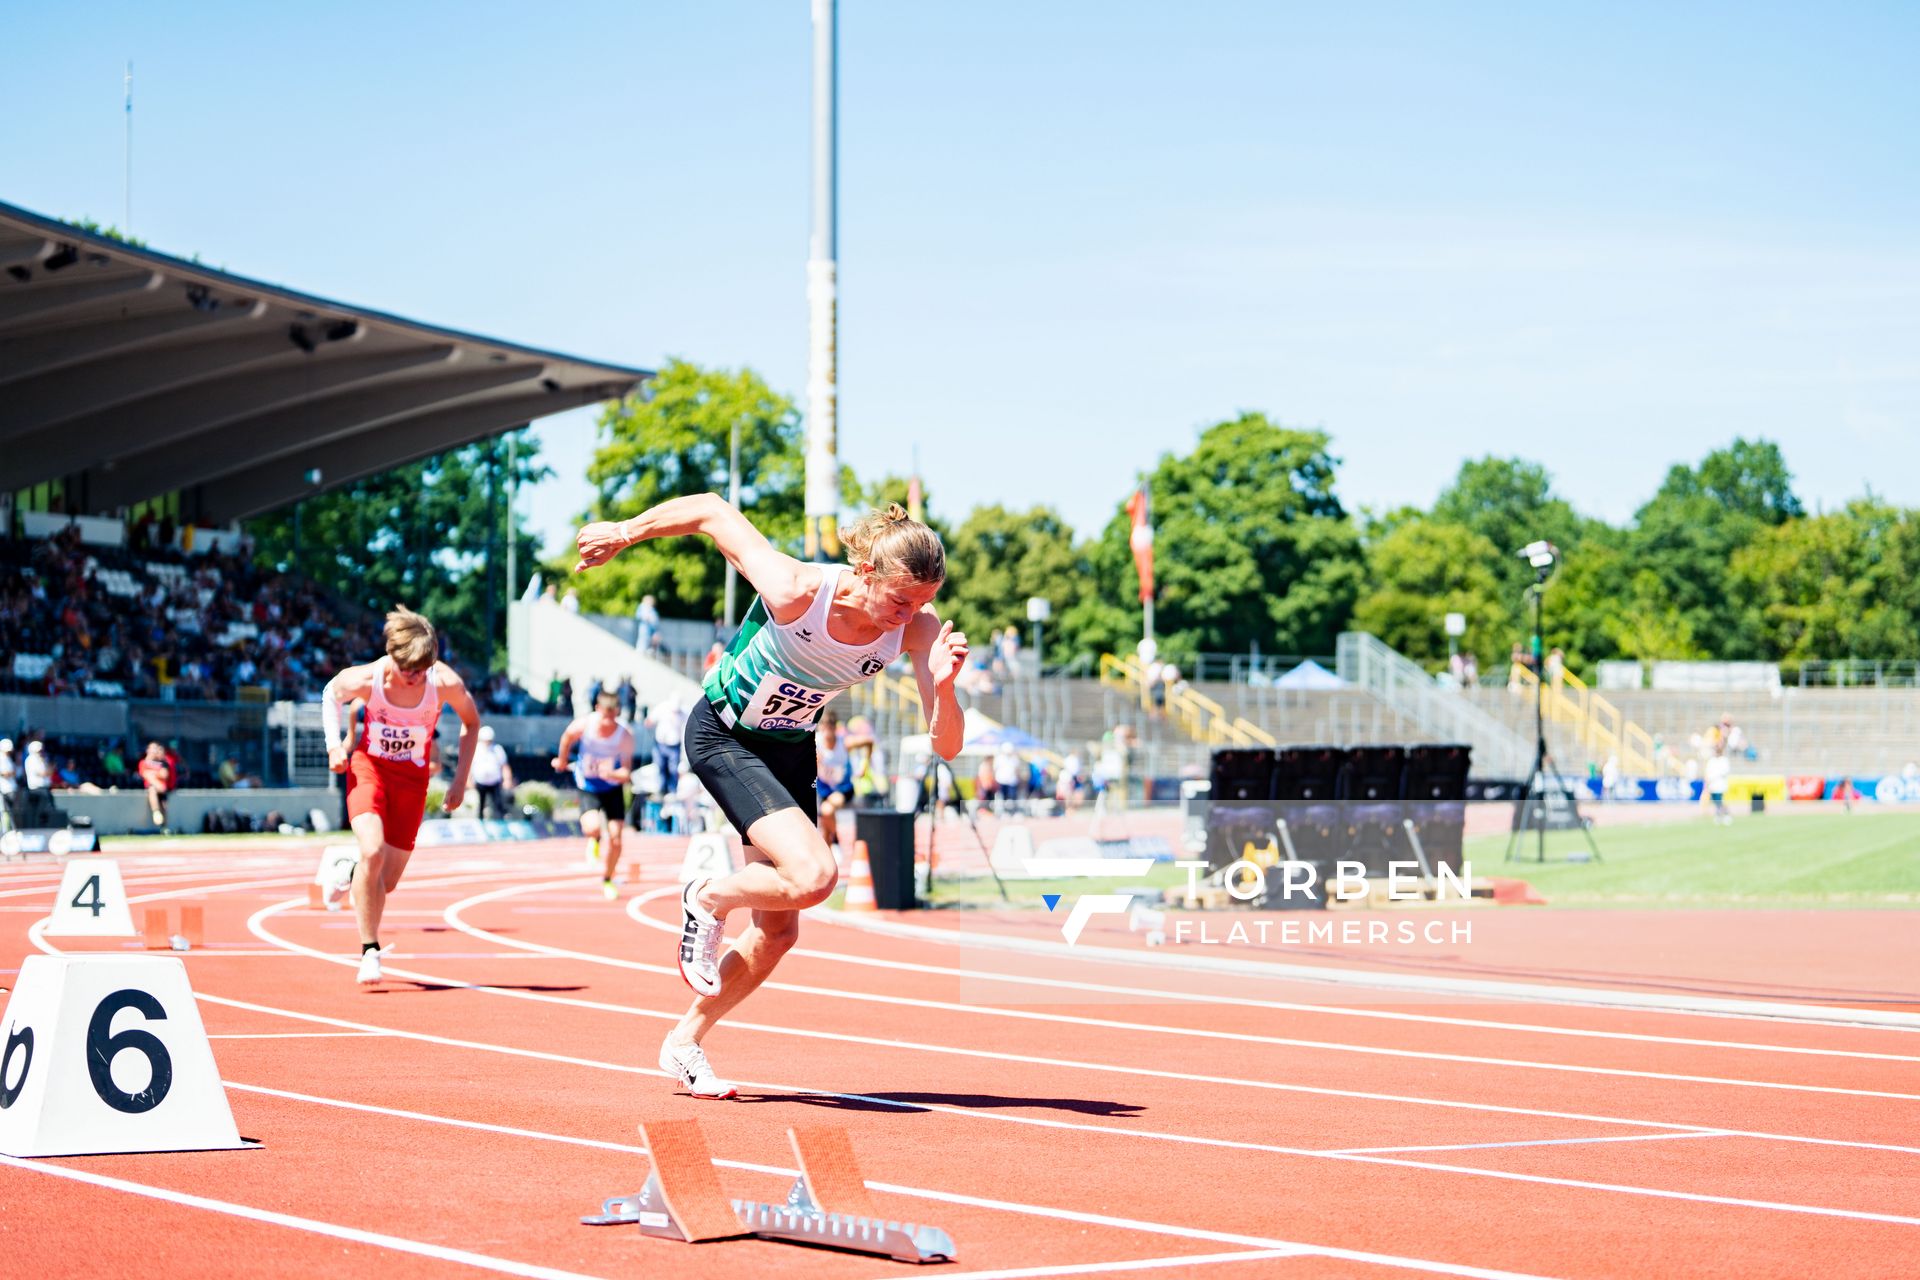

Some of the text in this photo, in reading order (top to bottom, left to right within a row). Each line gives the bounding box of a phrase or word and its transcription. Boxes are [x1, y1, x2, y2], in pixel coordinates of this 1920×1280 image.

[795, 631, 811, 643] erima
[779, 683, 826, 704] GLS
[382, 728, 410, 739] GLS
[380, 739, 416, 753] 990
[698, 844, 715, 870] 2
[71, 875, 106, 917] 4
[86, 988, 173, 1114] 6
